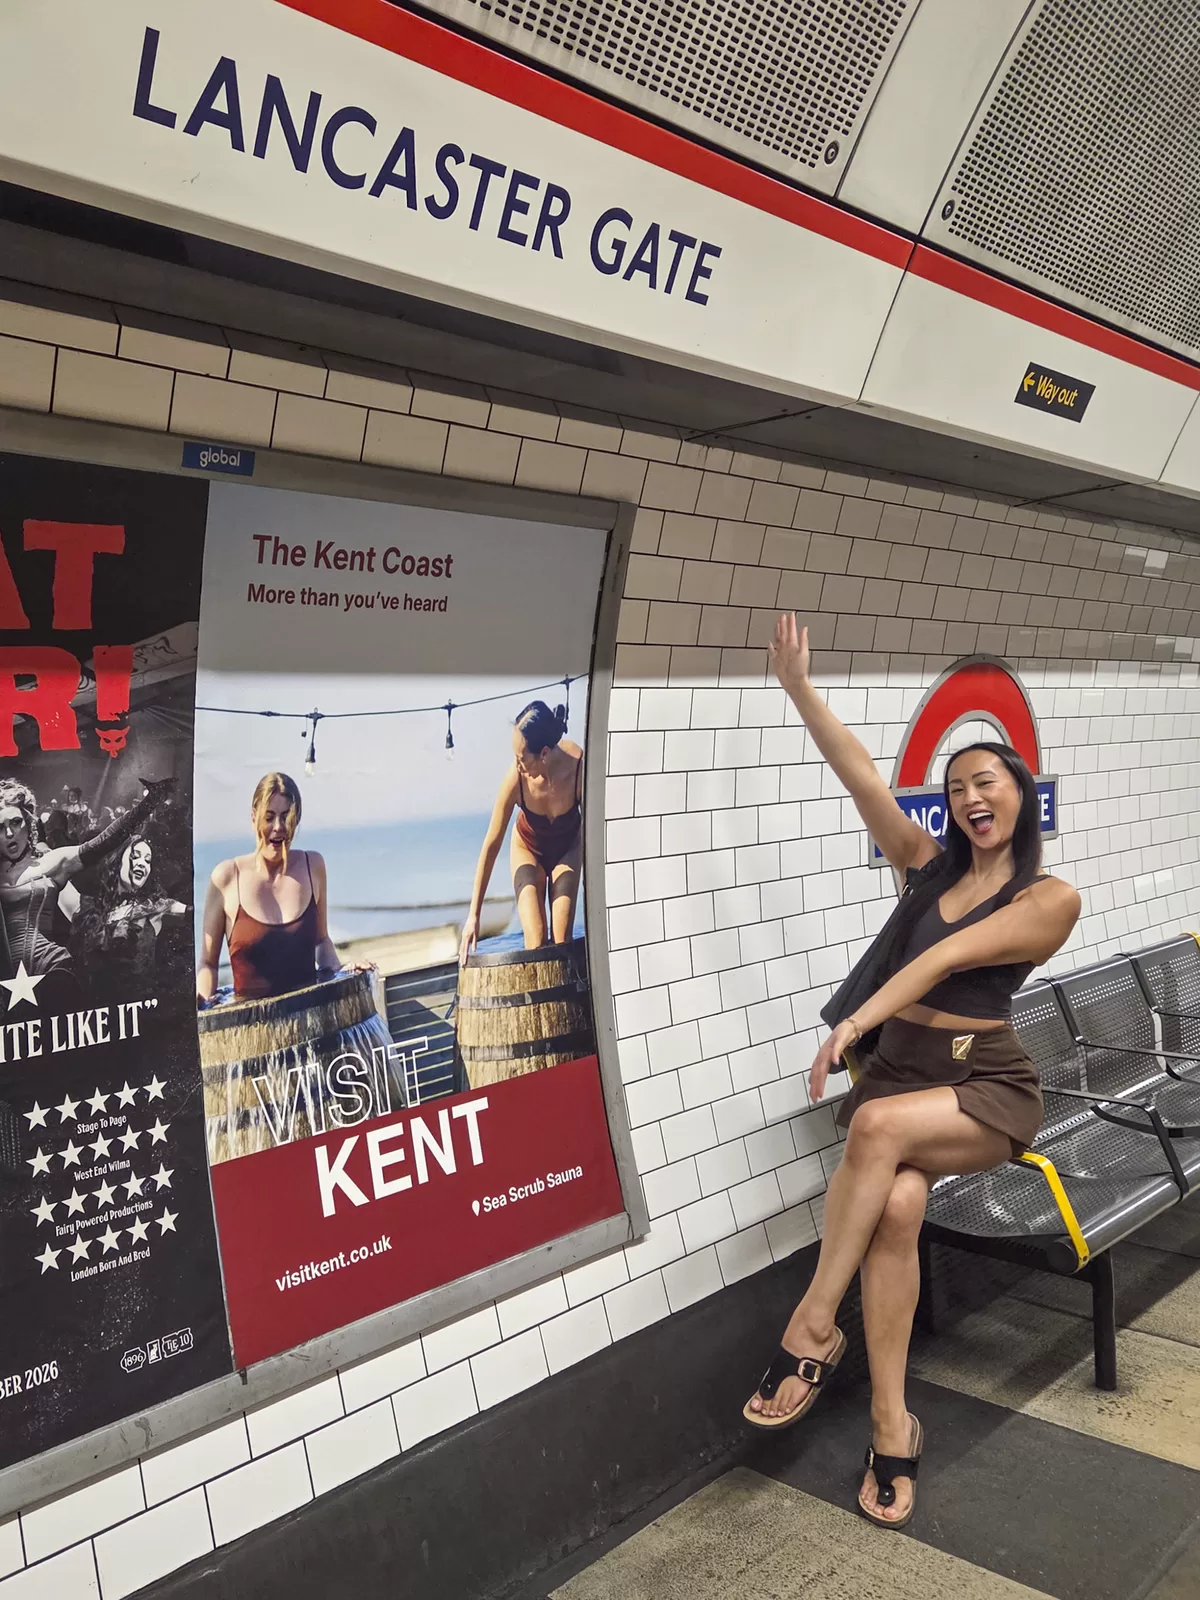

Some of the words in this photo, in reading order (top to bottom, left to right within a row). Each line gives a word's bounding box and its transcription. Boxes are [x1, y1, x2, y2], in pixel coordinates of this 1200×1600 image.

[133, 26, 572, 259] LANCASTER
[589, 207, 722, 305] GATE
[1036, 375, 1060, 405] Way
[1058, 388, 1078, 408] out
[200, 447, 241, 468] global
[253, 534, 306, 567] The
[314, 540, 376, 572] Kent
[383, 547, 453, 578] Coast
[247, 583, 295, 604] More
[300, 587, 339, 606] than
[344, 592, 399, 612] you’ve
[403, 593, 448, 612] heard
[50, 1007, 111, 1053] LIKE
[252, 1036, 429, 1145] VISIT
[77, 1122, 99, 1134] Stage
[100, 1118, 108, 1128] To
[109, 1115, 127, 1127] Page
[74, 1168, 93, 1181] West
[94, 1164, 107, 1177] End
[108, 1160, 130, 1172] Wilma
[314, 1097, 489, 1218] KENT
[482, 1196, 507, 1212] Sea
[509, 1178, 545, 1202] Scrub
[546, 1166, 583, 1188] Sauna
[55, 1223, 75, 1237] Fairy
[76, 1212, 108, 1230] Powered
[109, 1200, 153, 1220] Productions
[70, 1266, 98, 1282] London
[99, 1259, 117, 1273] Born
[118, 1252, 132, 1266] And
[133, 1247, 151, 1261] Bred
[275, 1235, 392, 1292] visitkent.co.uk
[24, 1360, 59, 1390] 2026
[124, 1352, 144, 1367] 1896
